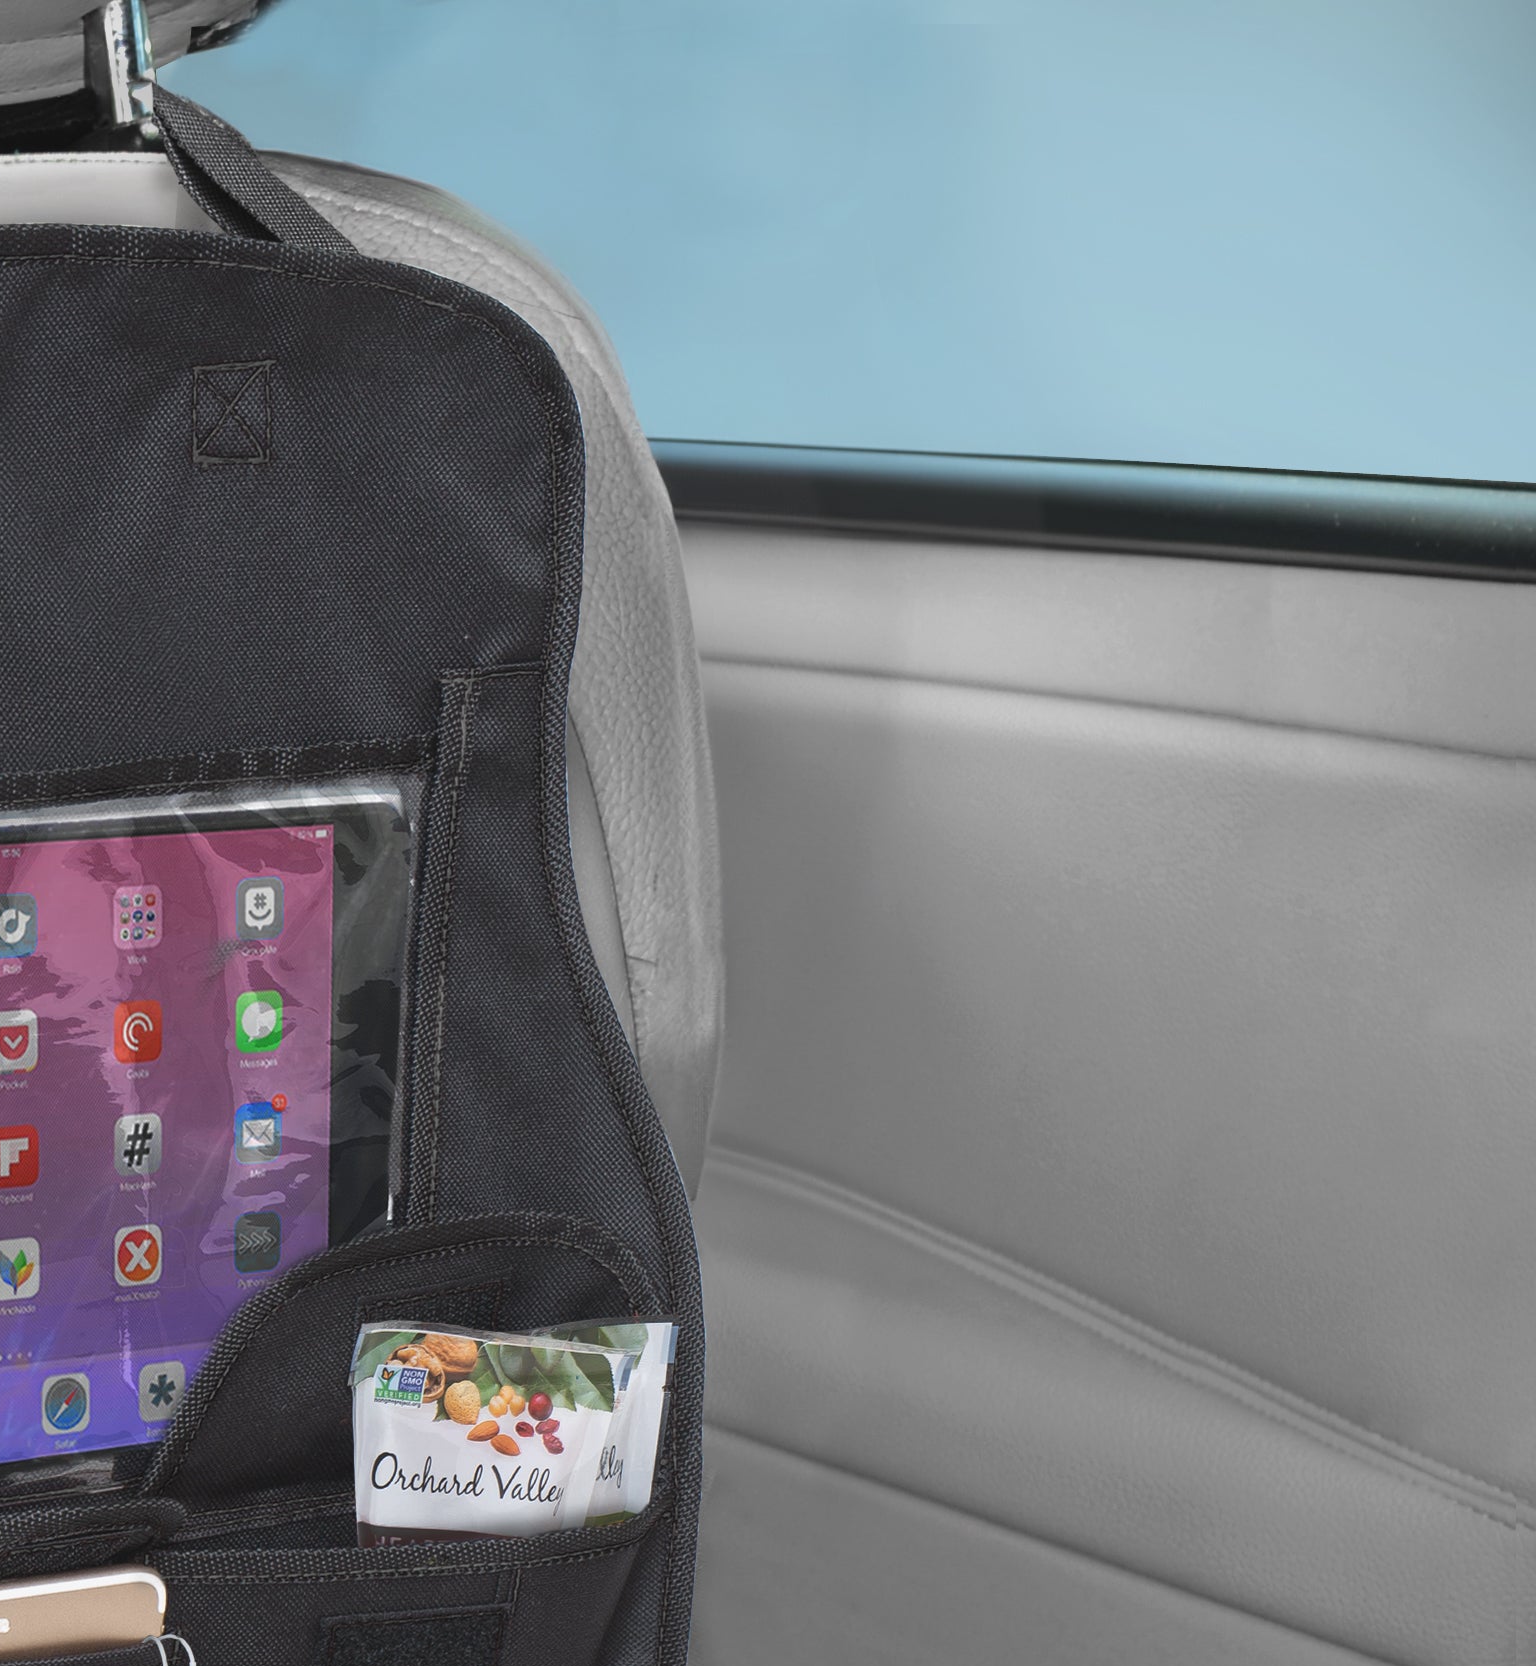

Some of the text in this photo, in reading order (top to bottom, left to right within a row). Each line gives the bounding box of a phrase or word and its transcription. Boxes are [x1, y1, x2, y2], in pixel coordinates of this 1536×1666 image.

[240, 1057, 278, 1069] Messages
[403, 1370, 424, 1378] NON
[401, 1376, 423, 1386] GMO
[377, 1389, 420, 1401] VERIFIED
[371, 1451, 564, 1517] Orchard Valley
